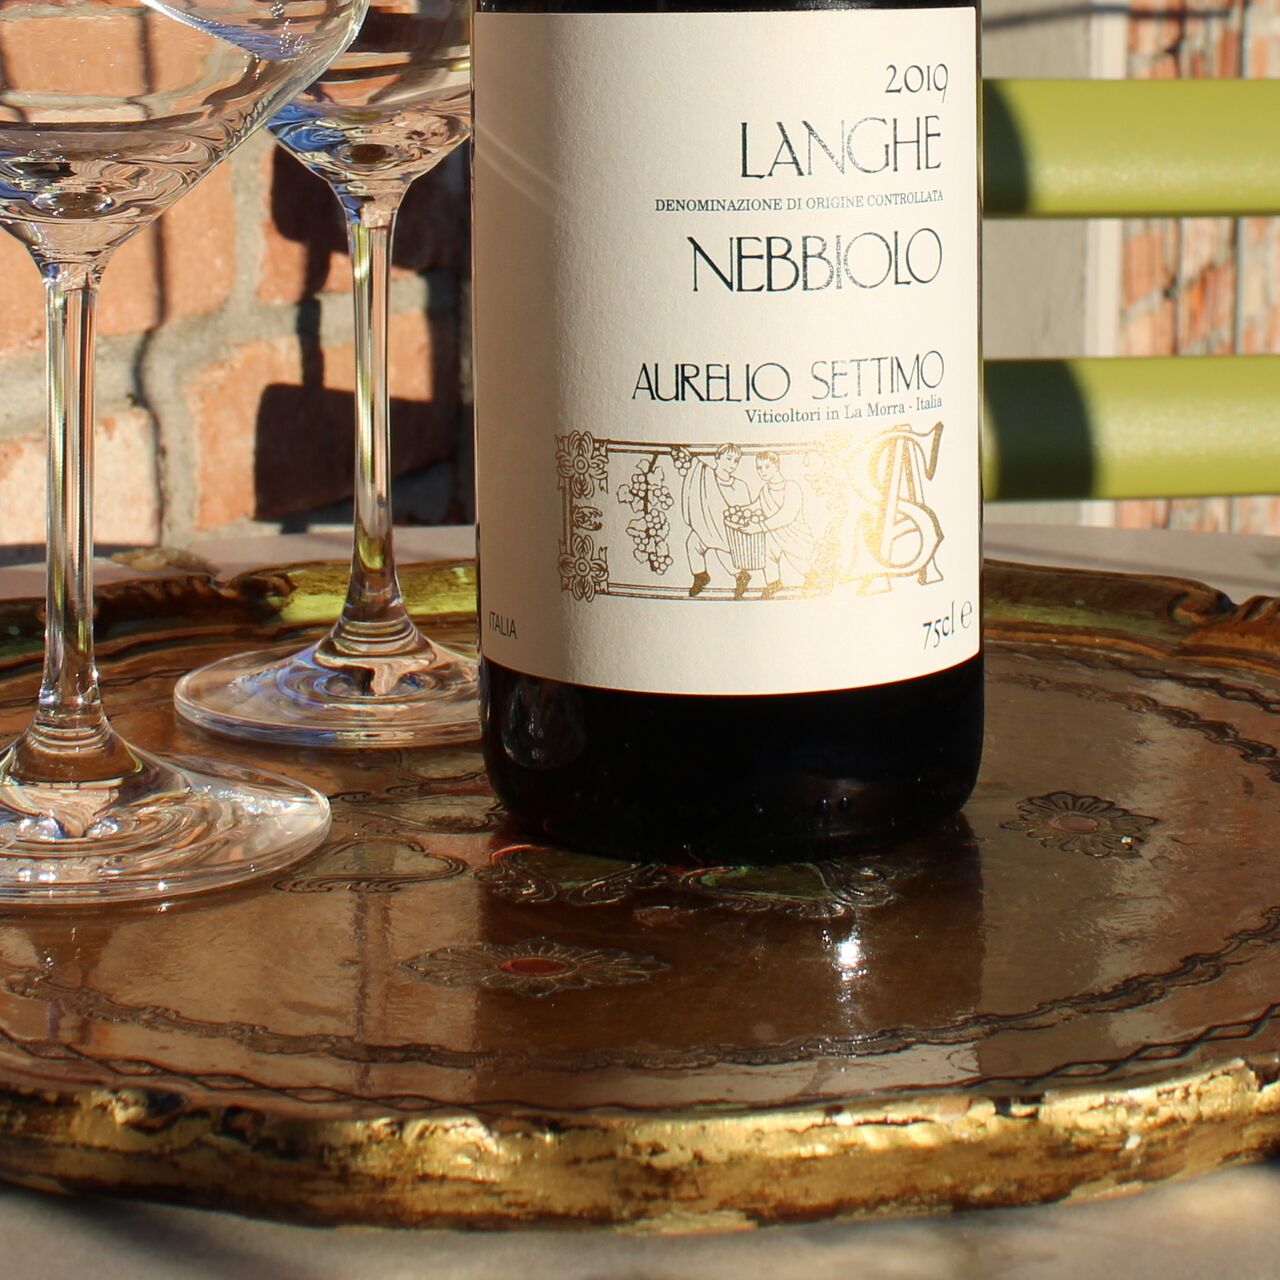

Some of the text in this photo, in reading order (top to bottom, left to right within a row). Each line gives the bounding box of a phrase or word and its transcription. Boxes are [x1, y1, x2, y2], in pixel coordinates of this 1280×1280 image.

[884, 62, 949, 105] 2019
[740, 114, 942, 180] LANGHE
[654, 189, 944, 212] DENOMINAZIONE DI ORIGINE CONTROLLATA
[686, 227, 943, 293] NEBBIOLO
[631, 349, 945, 403] AURELIO SETTIMO
[744, 407, 821, 424] Viticoltori
[826, 406, 840, 421] in
[843, 404, 863, 419] La
[866, 401, 905, 418] Morra
[915, 394, 943, 412] Italia
[488, 610, 518, 640] ITALIA
[922, 599, 956, 651] 75cl
